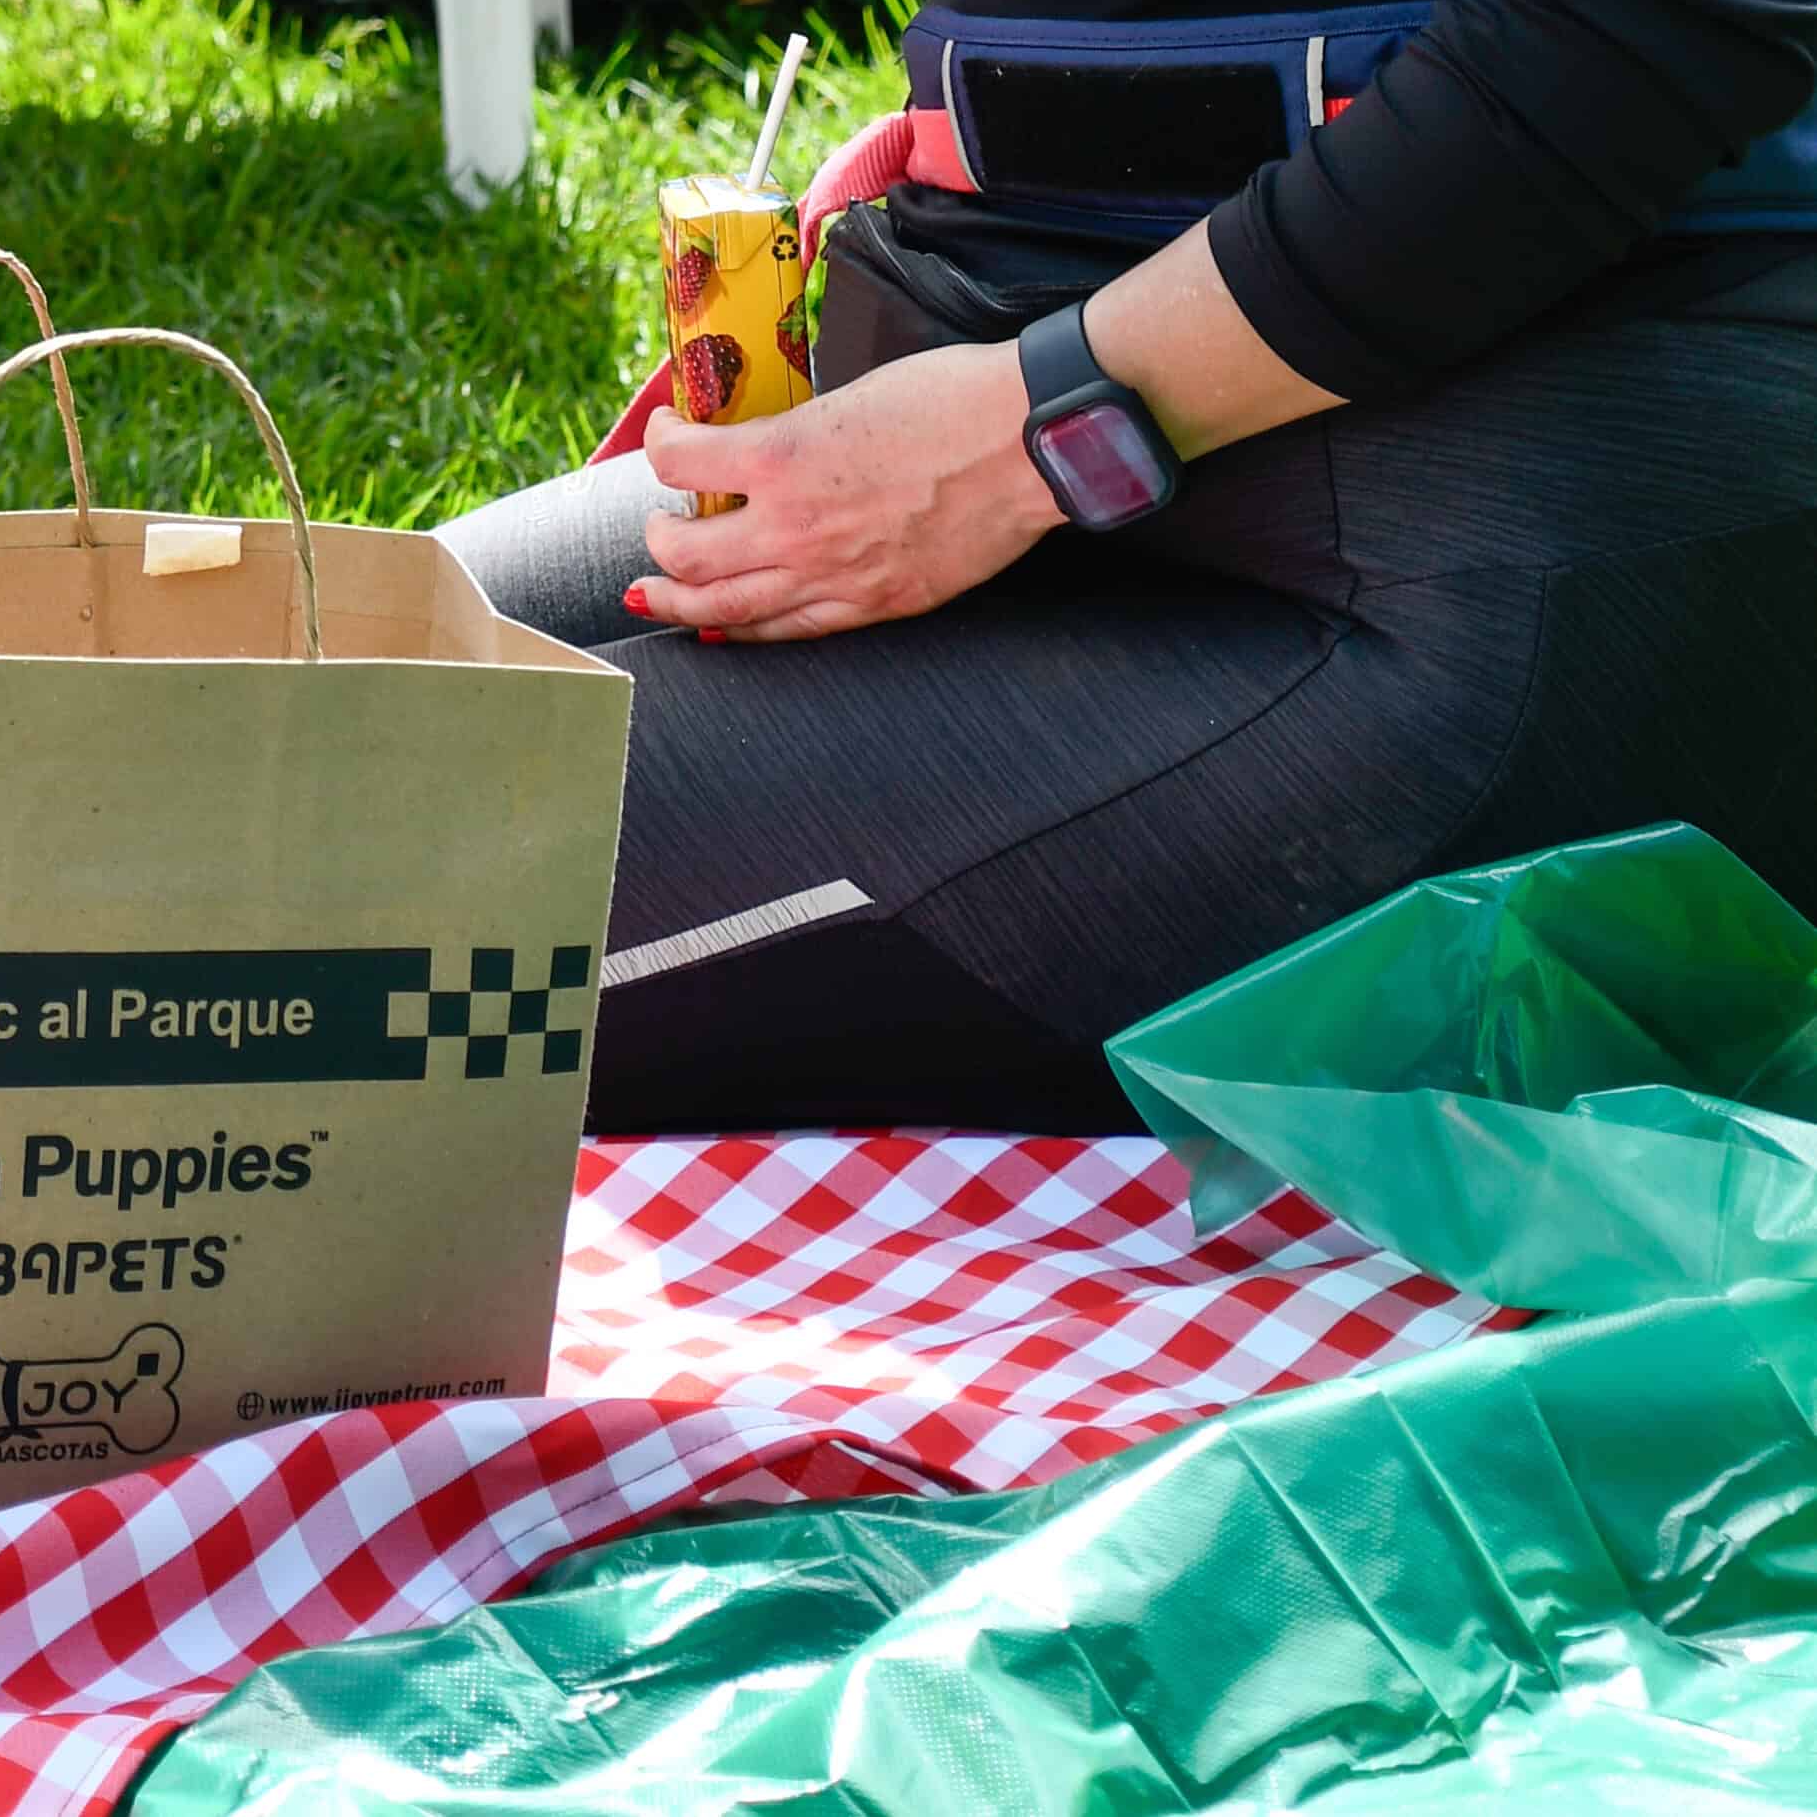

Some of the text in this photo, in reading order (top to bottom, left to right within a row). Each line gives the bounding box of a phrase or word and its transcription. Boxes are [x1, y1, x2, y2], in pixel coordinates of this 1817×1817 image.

[39, 989, 88, 1040] al
[110, 988, 315, 1049] Parque
[22, 1130, 313, 1211] Puppies
[23, 1378, 138, 1417] JOY
